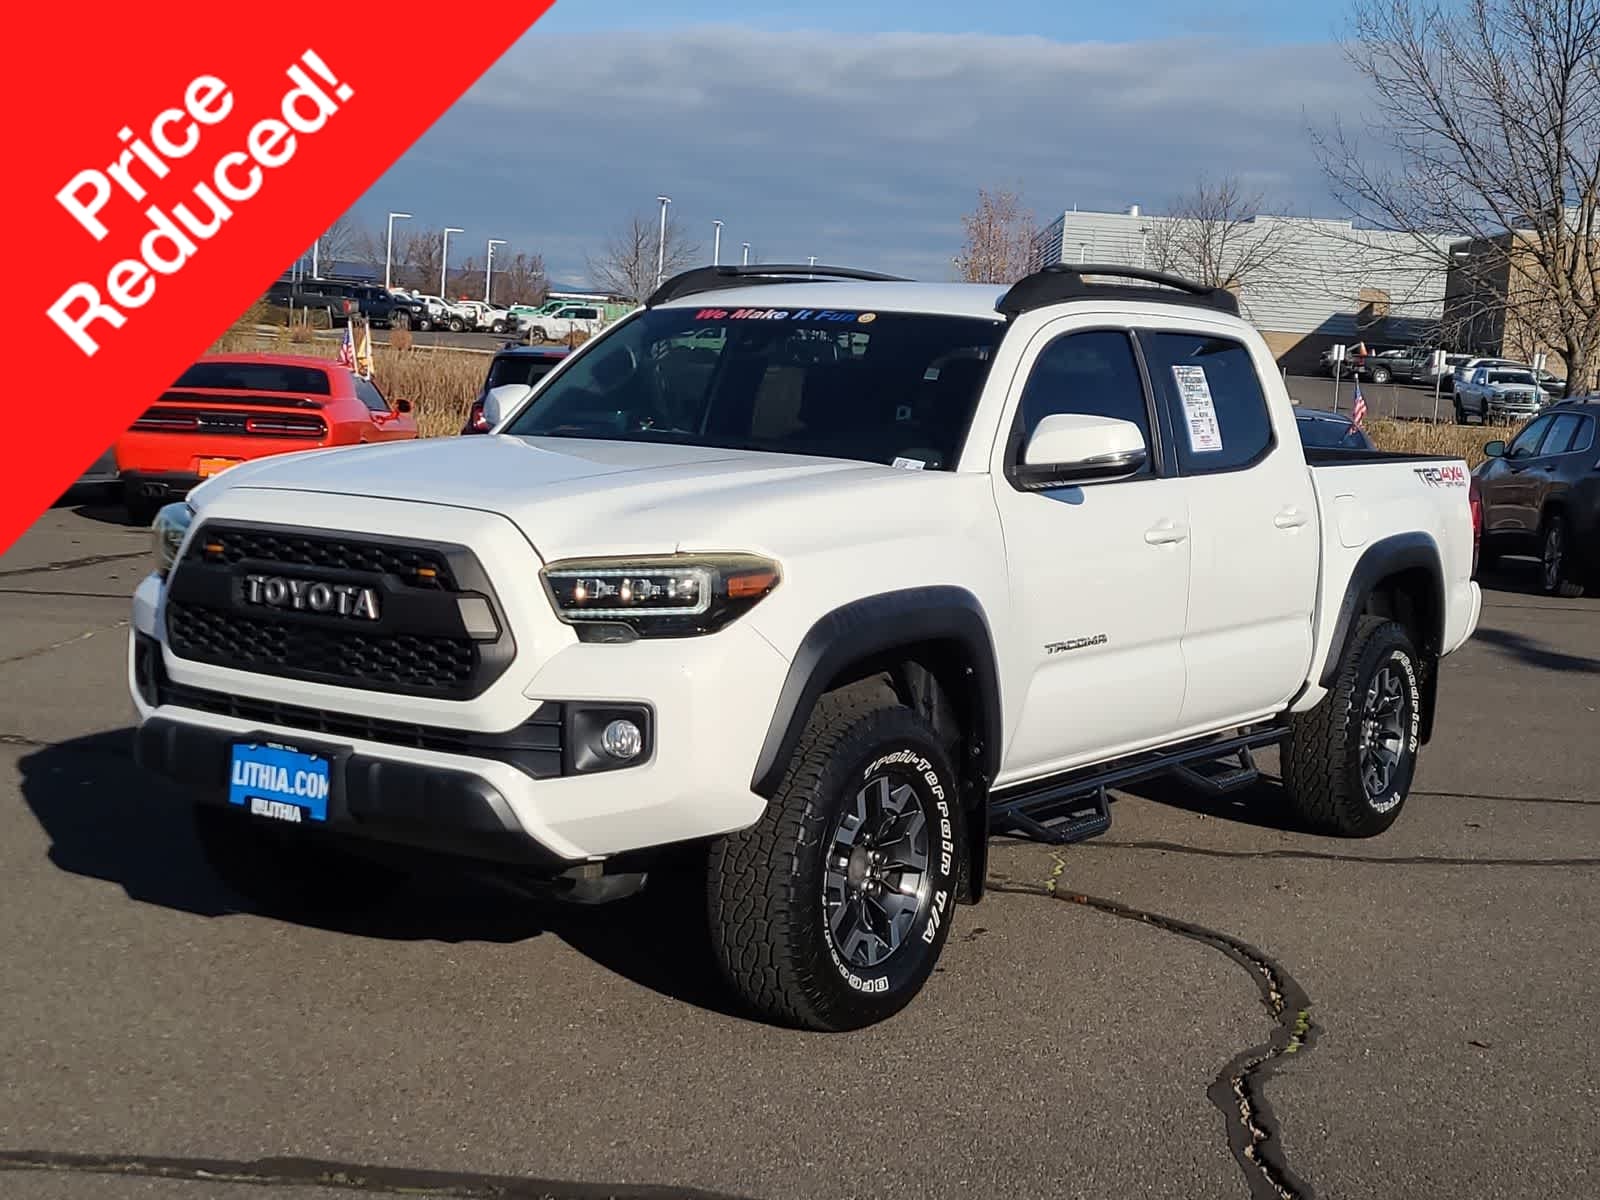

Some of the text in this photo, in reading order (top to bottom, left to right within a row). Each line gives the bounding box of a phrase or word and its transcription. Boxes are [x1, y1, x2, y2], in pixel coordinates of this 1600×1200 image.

[695, 308, 856, 322] We Make It Fun
[246, 574, 380, 620] TOYOTA
[1044, 633, 1108, 655] TACOMA
[231, 759, 330, 800] LITHIA.COM
[264, 799, 302, 823] LITHIA
[922, 889, 948, 944] T/A
